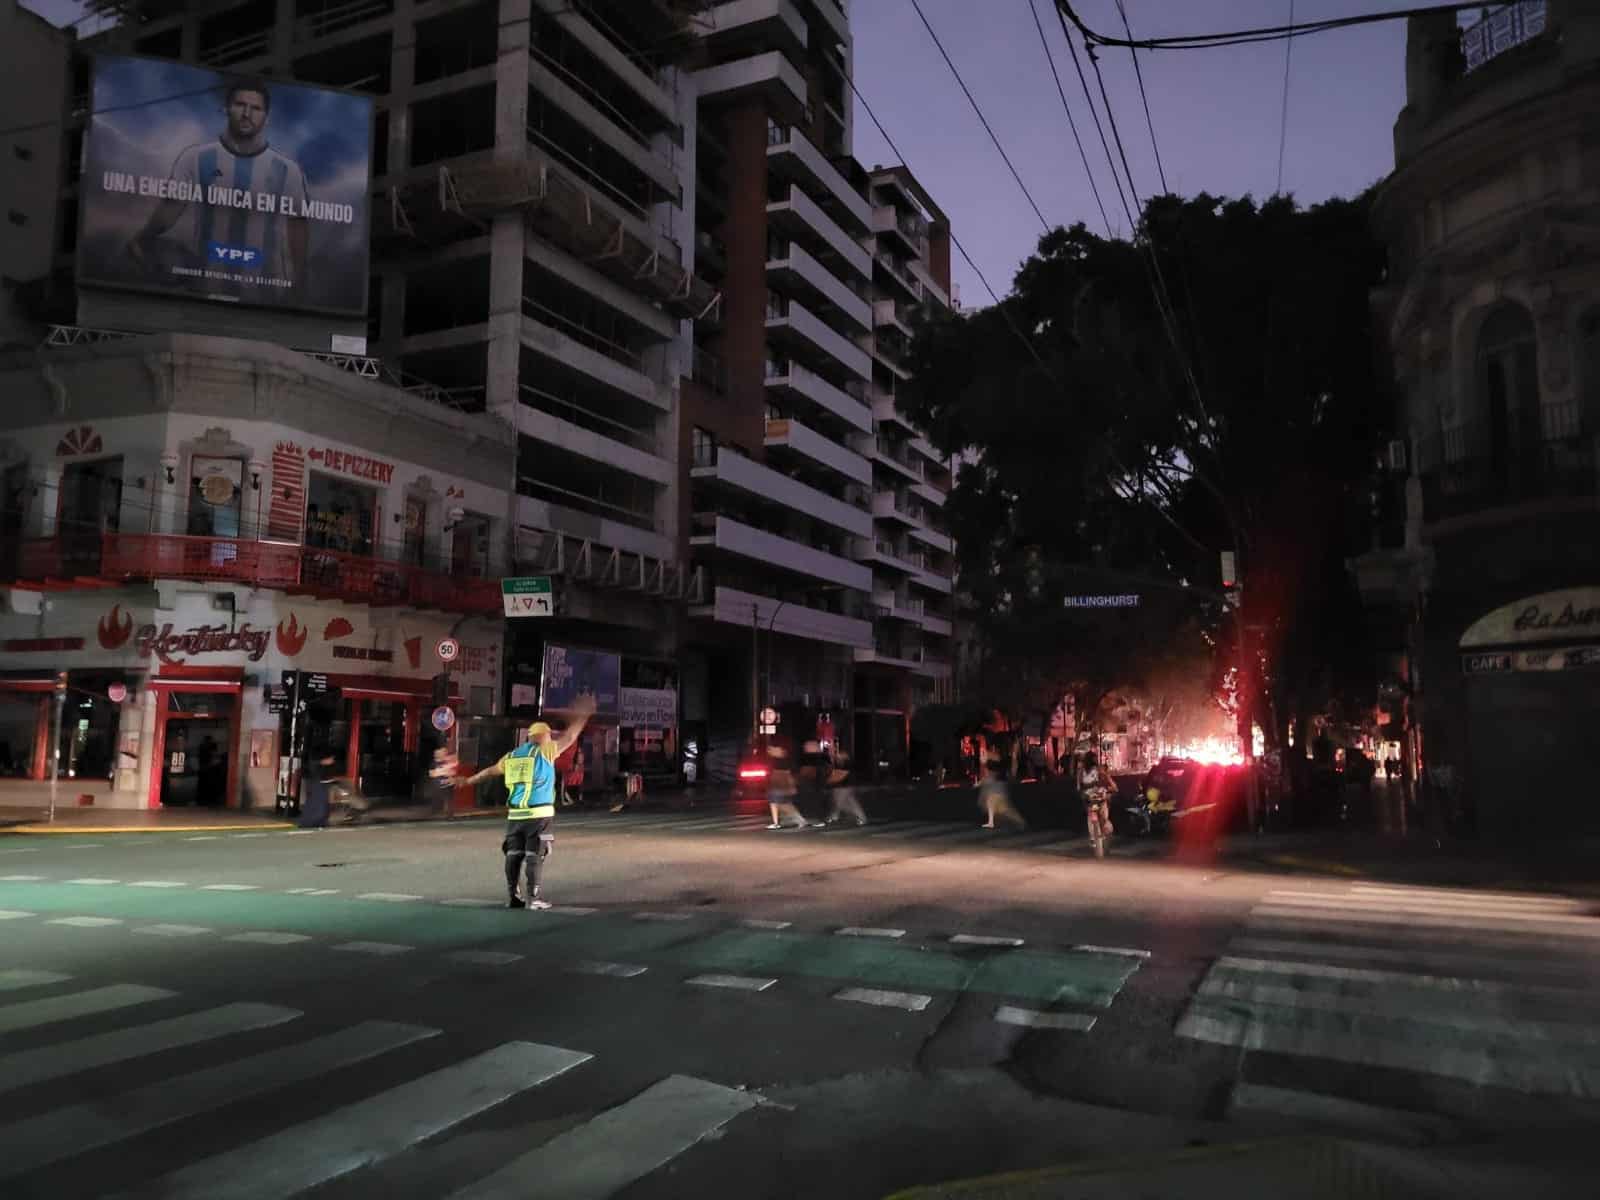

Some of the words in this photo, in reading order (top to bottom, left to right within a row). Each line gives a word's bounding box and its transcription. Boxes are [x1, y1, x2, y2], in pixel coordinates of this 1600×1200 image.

[103, 170, 136, 194] UNA
[256, 192, 276, 213] EN
[279, 195, 298, 217] EL
[301, 199, 353, 224] MUNDO
[215, 247, 256, 261] YPF
[1063, 595, 1138, 607] BILLINGHURST
[135, 623, 271, 665] Kentucky
[441, 644, 453, 655] 50
